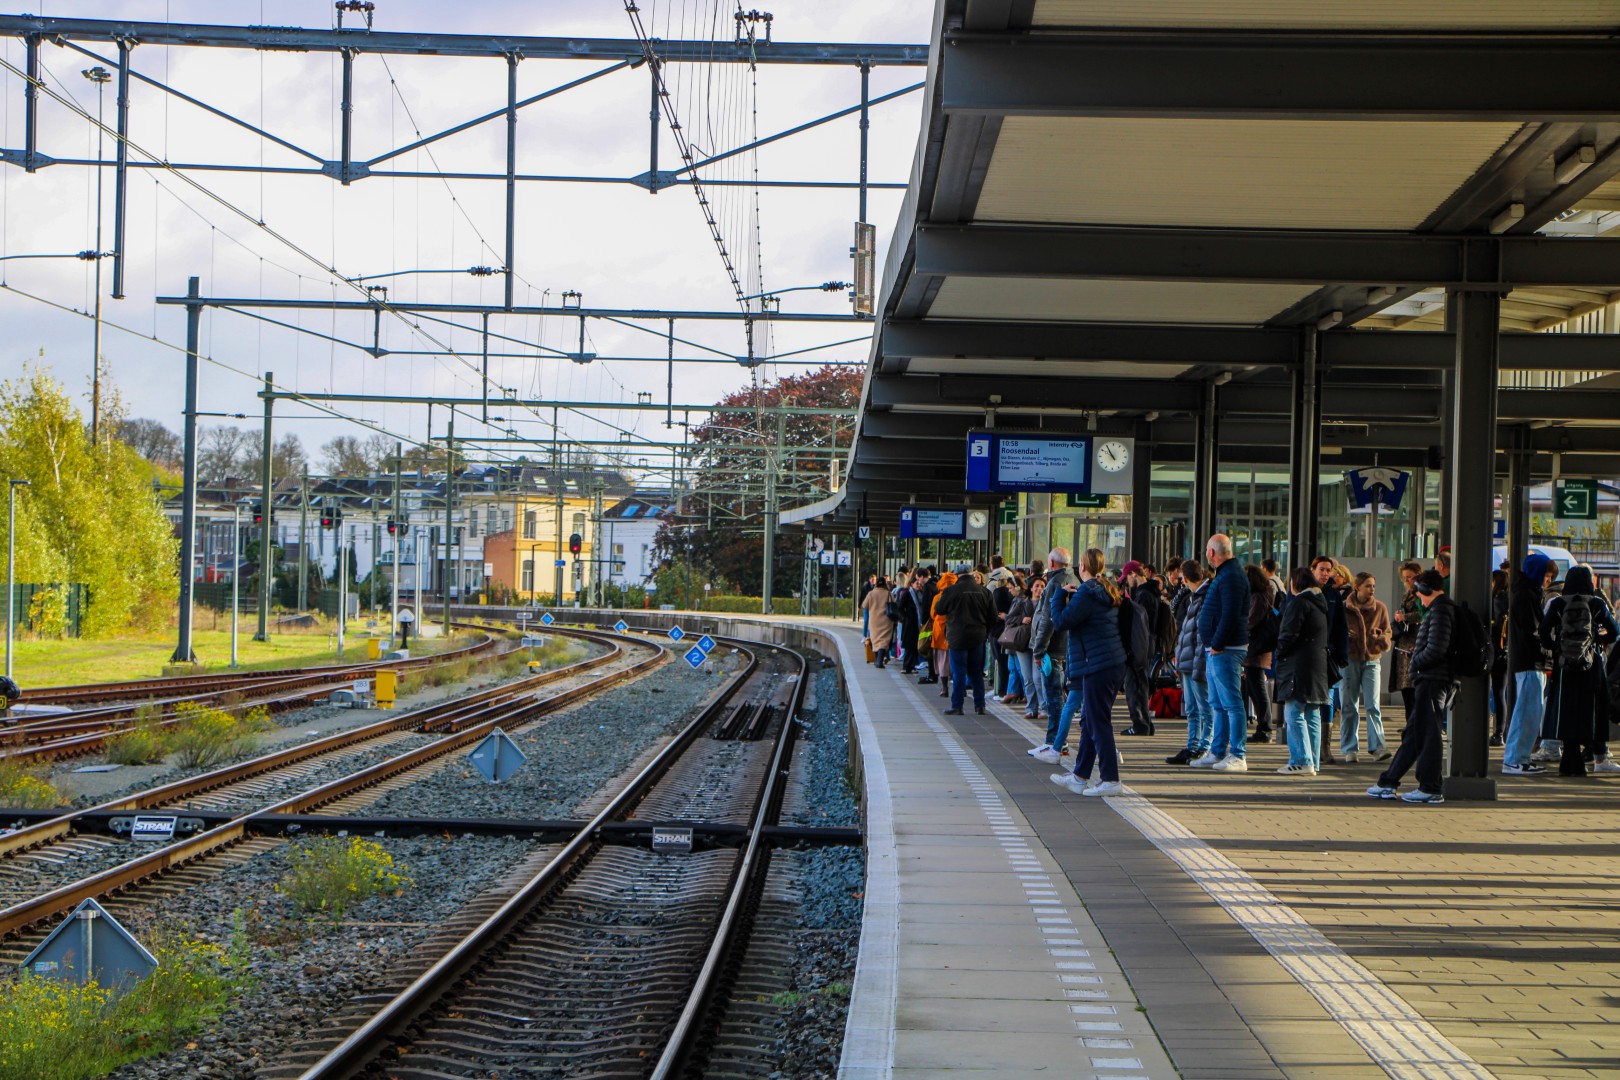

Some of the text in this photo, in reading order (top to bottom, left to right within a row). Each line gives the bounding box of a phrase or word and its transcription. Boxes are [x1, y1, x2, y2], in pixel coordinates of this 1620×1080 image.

[976, 446, 983, 455] 3
[860, 528, 868, 537] V
[703, 640, 709, 648] 4
[692, 653, 699, 662] 2
[134, 822, 173, 831] STRAIL
[654, 834, 690, 843] STRAIL
